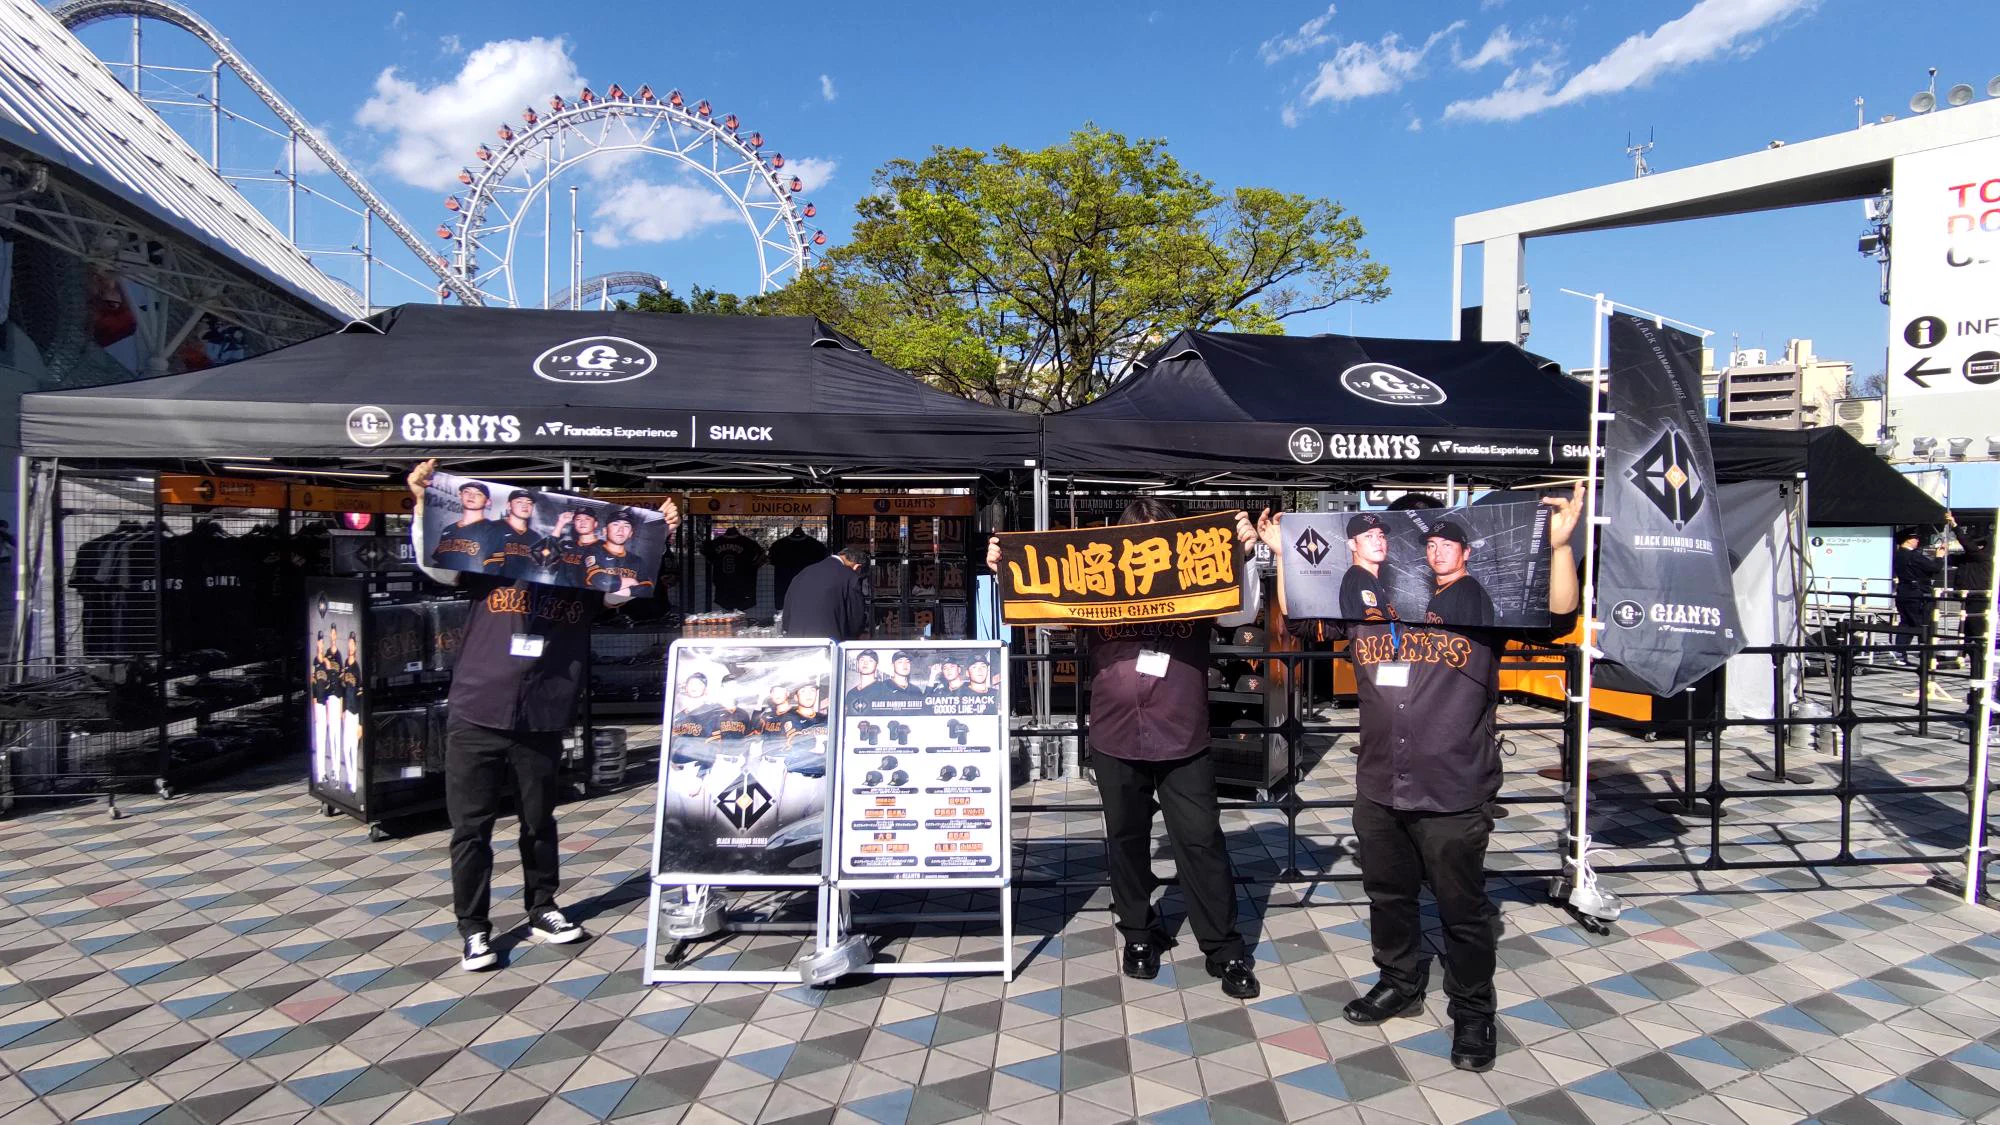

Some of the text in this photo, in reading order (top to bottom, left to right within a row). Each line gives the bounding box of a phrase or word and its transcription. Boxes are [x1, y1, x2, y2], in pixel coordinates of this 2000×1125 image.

[401, 413, 521, 443] GIANTS
[564, 425, 612, 437] Fanatics
[613, 427, 678, 439] Experience
[709, 426, 773, 441] SHACK
[1330, 434, 1421, 460] GIANTS
[1453, 444, 1490, 455] Fanatics
[1490, 445, 1539, 457] Experience
[752, 503, 813, 514] UNIFORM
[894, 498, 936, 509] GIANTS
[1634, 535, 1660, 547] BLACK
[1662, 536, 1694, 549] DIAMOND
[1127, 602, 1176, 617] GIANTS
[1650, 604, 1721, 626] GIANTS
[925, 695, 995, 706] GIANTS SHACK
[934, 703, 987, 714] GOODS LINE-UP
